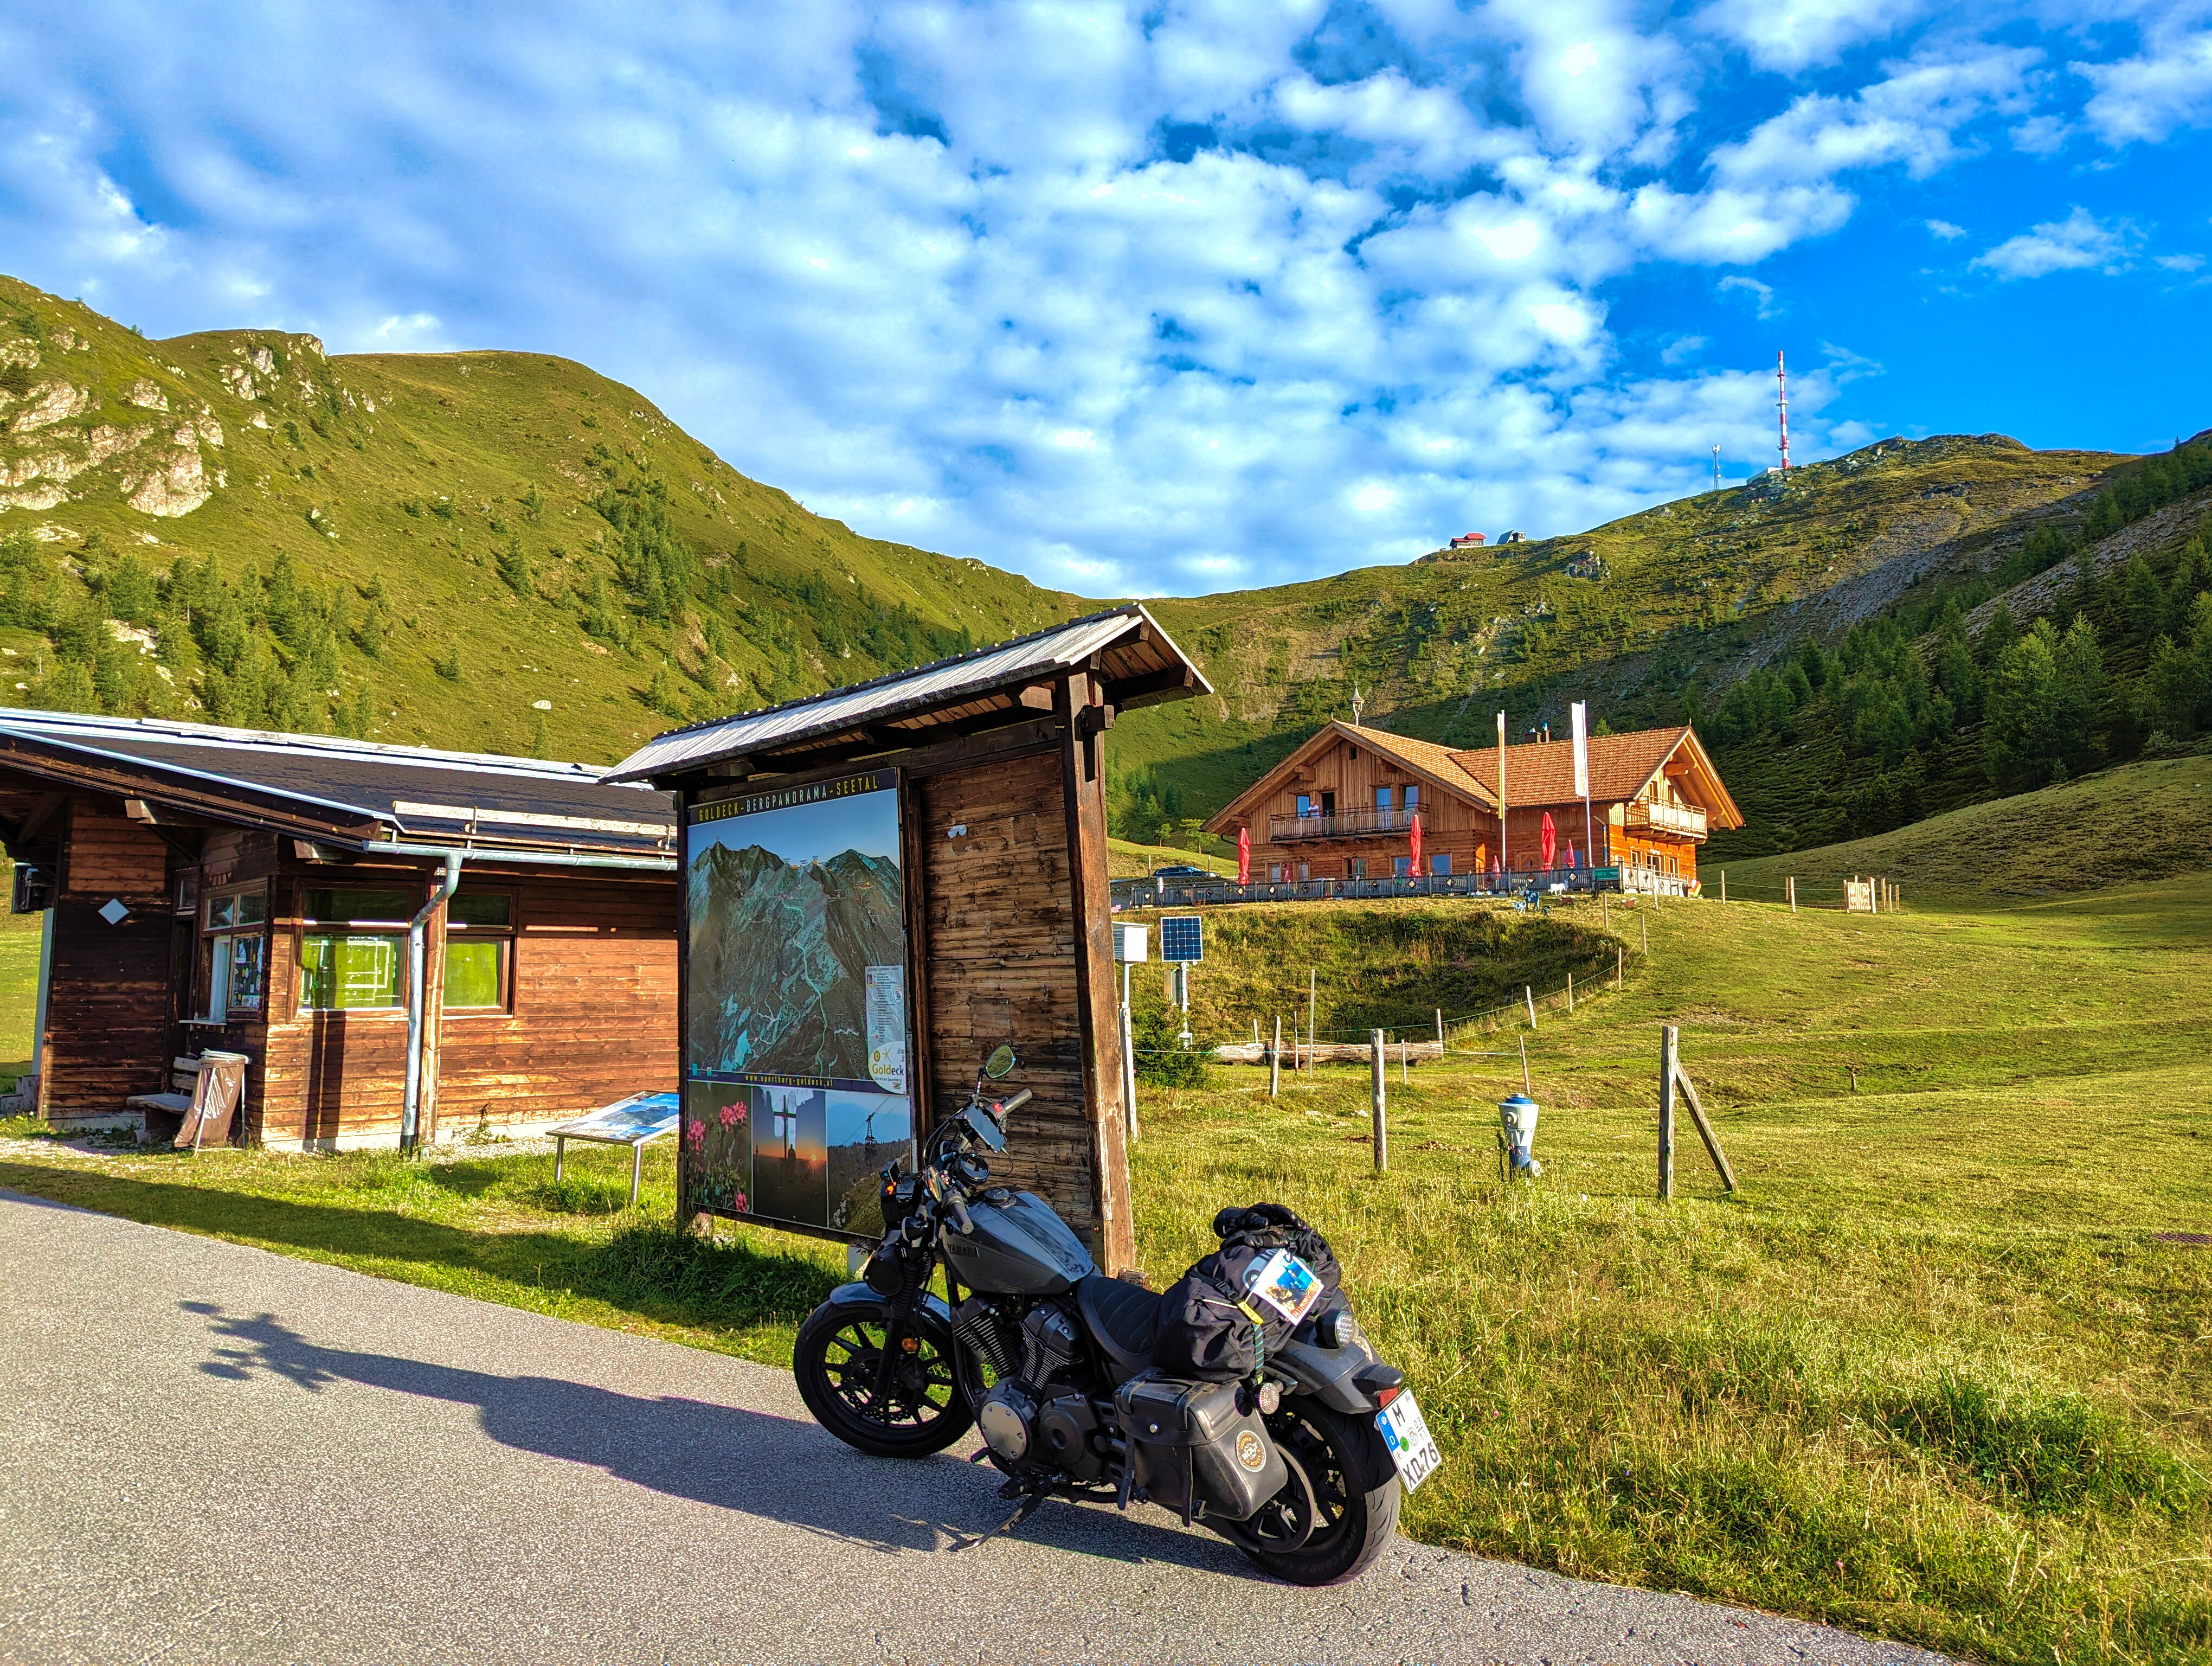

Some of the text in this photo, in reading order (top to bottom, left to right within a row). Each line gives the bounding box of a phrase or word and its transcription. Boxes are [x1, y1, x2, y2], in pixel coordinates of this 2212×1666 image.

[872, 1063, 904, 1076] Goldeck
[745, 1075, 833, 1087] www.sportberg-goldeck.at
[947, 1243, 979, 1258] YAMAHA
[1391, 1402, 1406, 1427] M
[1413, 1417, 1422, 1429] 03
[1389, 1435, 1396, 1446] D
